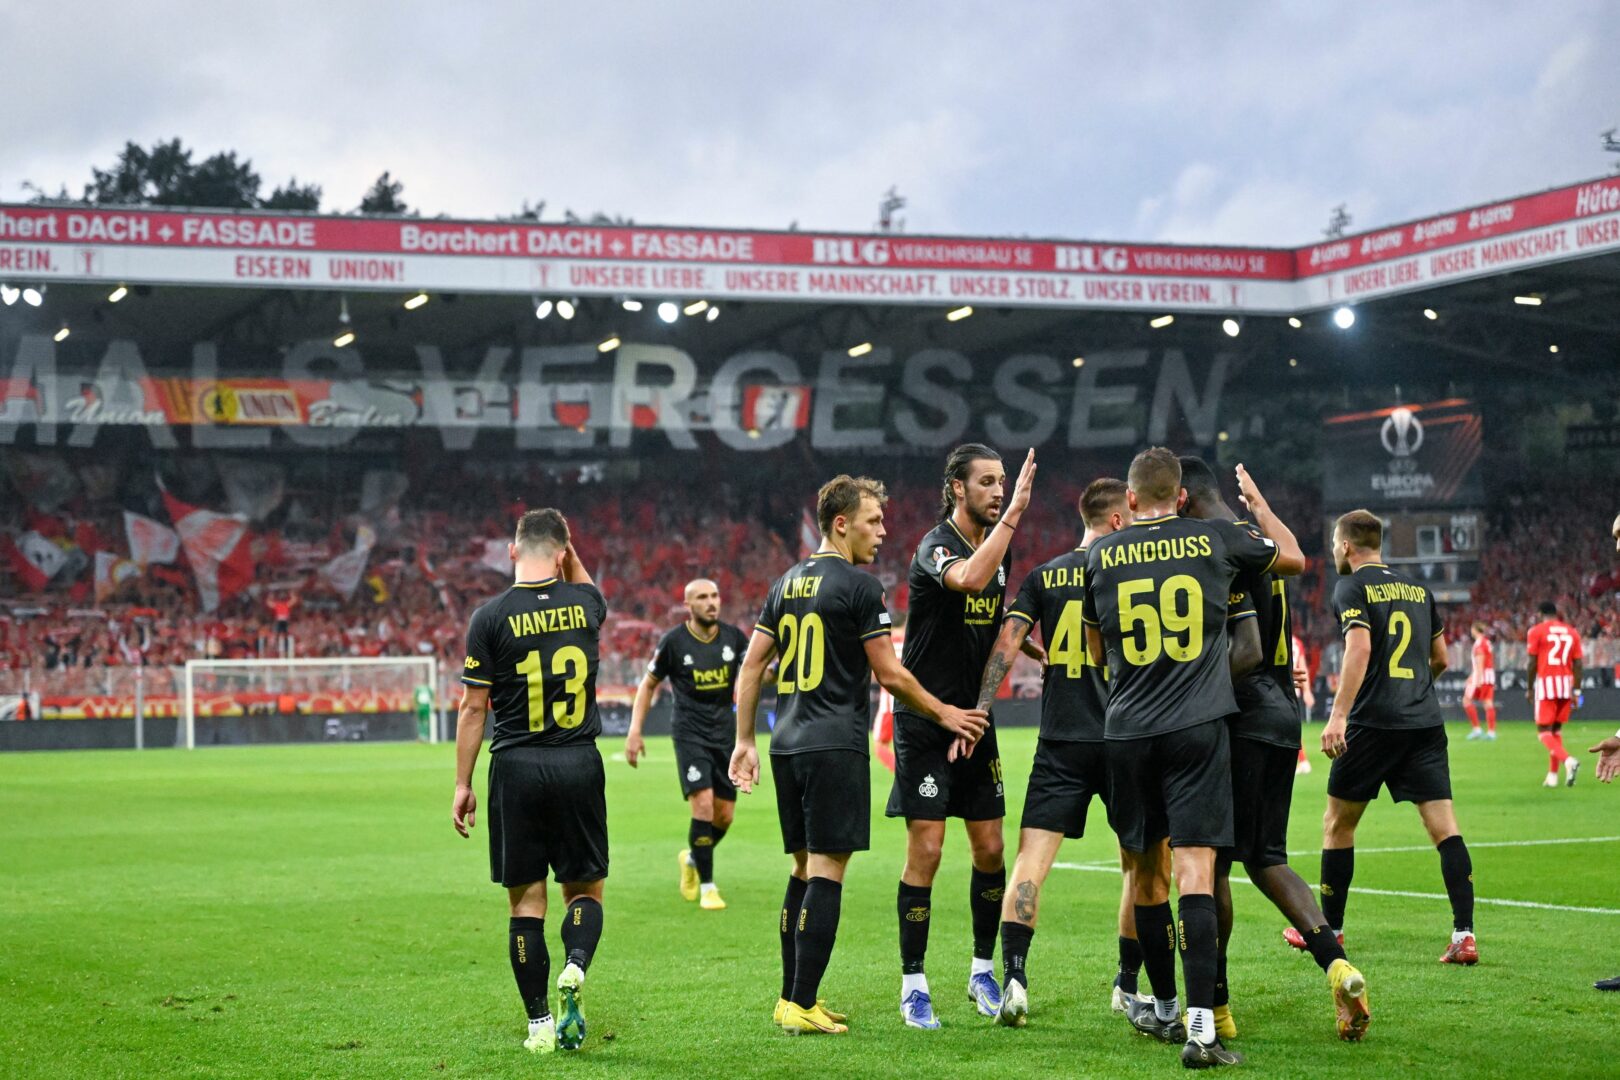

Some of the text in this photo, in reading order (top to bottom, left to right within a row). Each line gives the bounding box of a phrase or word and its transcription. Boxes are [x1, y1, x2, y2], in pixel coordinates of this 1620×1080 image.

[0, 211, 58, 238] hert
[67, 214, 149, 241] DACH
[182, 218, 316, 247] FASSADE
[400, 225, 520, 253] Borchert
[527, 230, 601, 256] DACH
[632, 233, 754, 261] FASSADE
[235, 254, 404, 282] EISERN UNION!
[812, 238, 890, 265] BUG
[893, 244, 1012, 266] VERKEHRSBAU
[1055, 246, 1128, 272] BUG
[1135, 251, 1246, 273] VERKEHRSBAU
[570, 264, 1216, 305] UNSERE LIEBE. UNSERE MANNSCHAFT. UNSER STOLZ. UNSER VEREIN.
[1344, 267, 1387, 295] UNSERE
[1430, 249, 1476, 277] UNSERE
[1100, 535, 1212, 570] KANDOUSS
[783, 575, 823, 600] LYNEN
[1364, 581, 1426, 604] NIEUWKOOP
[508, 605, 588, 638] VANZEIR
[1117, 574, 1204, 667] 59
[777, 612, 825, 695] 20
[1388, 610, 1415, 679] 2
[1546, 633, 1573, 666] 27
[515, 645, 589, 733] 13
[693, 665, 729, 684] hey!
[517, 935, 527, 964] RUSG
